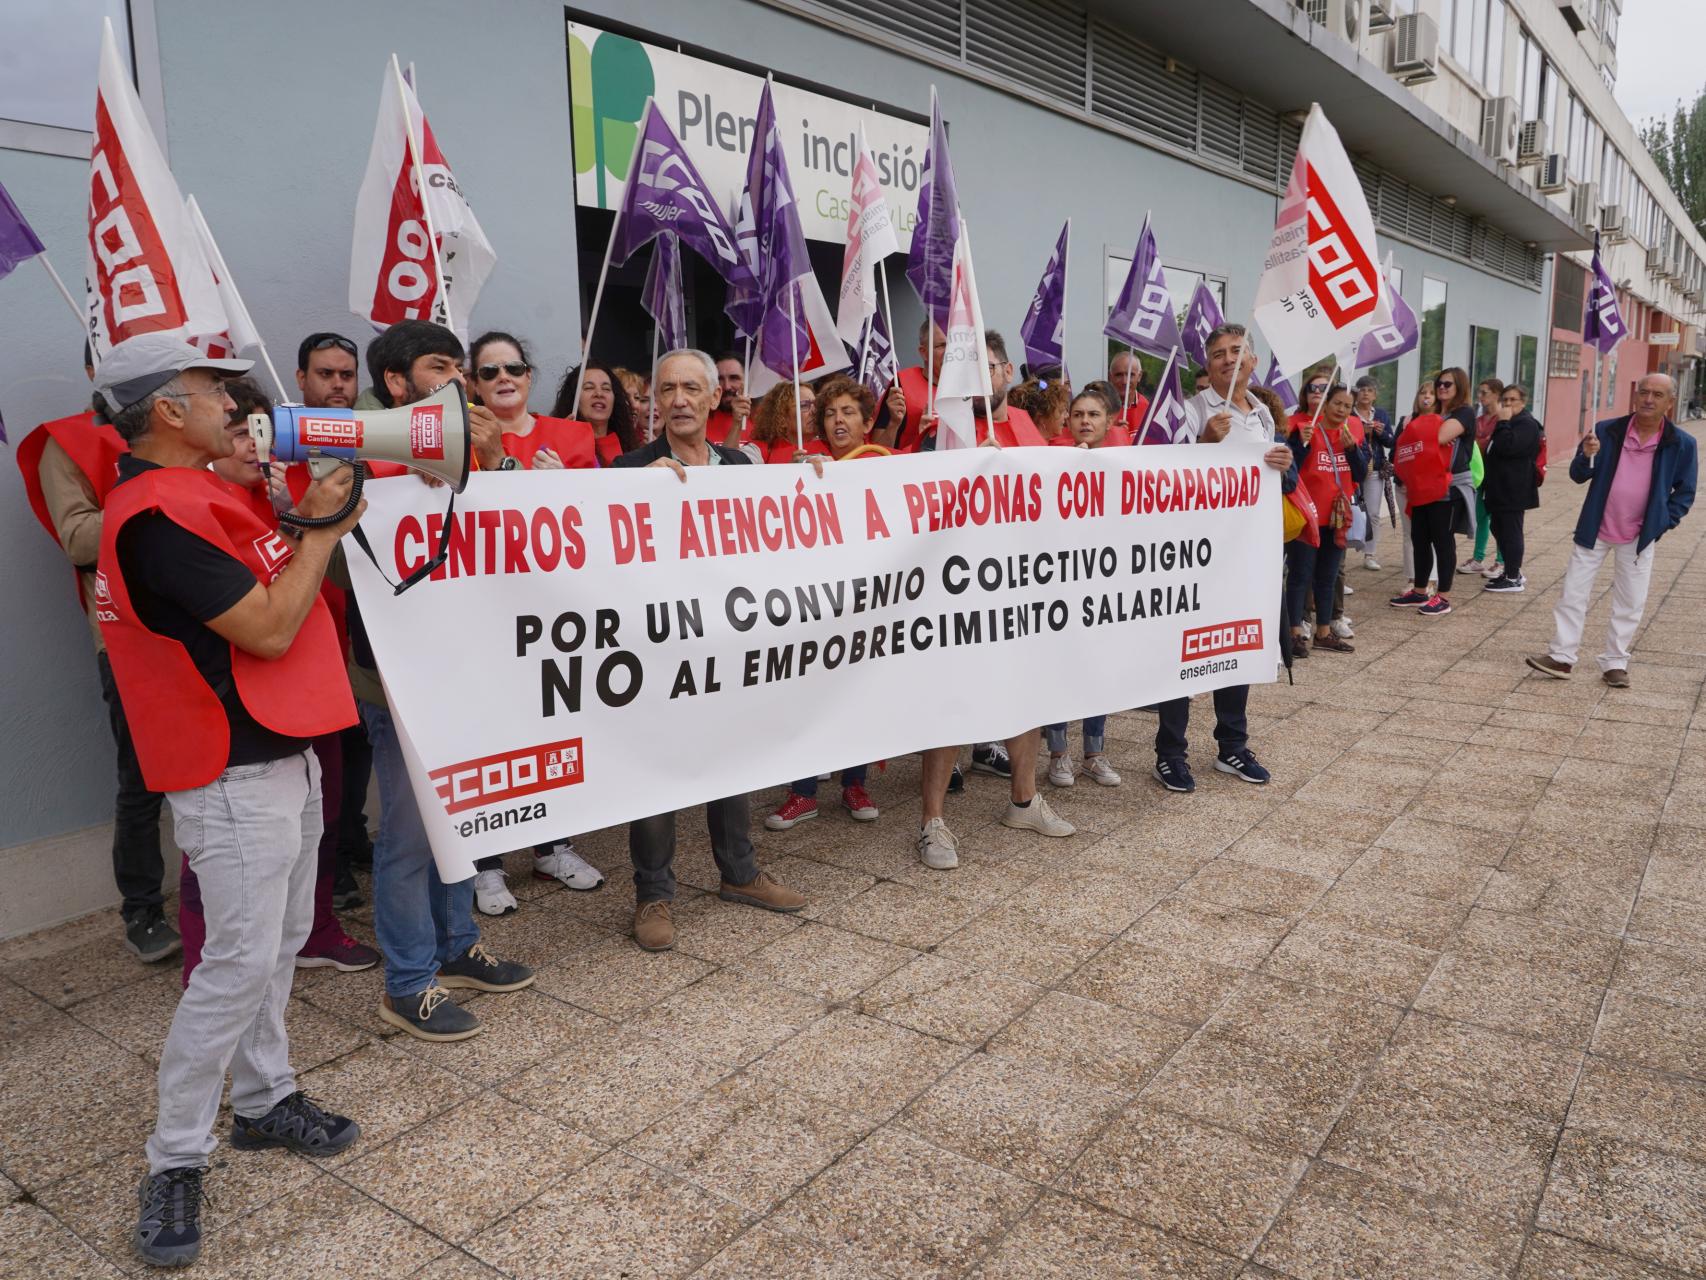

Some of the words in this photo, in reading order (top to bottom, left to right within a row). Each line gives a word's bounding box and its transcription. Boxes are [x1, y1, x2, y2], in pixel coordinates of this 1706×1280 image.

[677, 89, 757, 154] Plen
[637, 138, 738, 265] CCOO
[637, 200, 687, 222] mujer
[307, 435, 333, 443] Castilla
[394, 506, 587, 583] CENTROS
[608, 502, 657, 565] DE
[679, 477, 843, 560] ATENCIÓN
[866, 488, 891, 541] A
[903, 472, 1043, 535] PERSONAS
[1056, 470, 1106, 520] CON
[1120, 465, 1261, 516] DISCAPACIDAD
[516, 608, 621, 657] POR
[646, 598, 704, 644] UN
[724, 566, 925, 632] CONVENIO
[942, 546, 1118, 595] COLECTIVO
[1131, 537, 1213, 575] DIGNO
[541, 650, 643, 718] NO
[669, 656, 721, 700] AL
[742, 599, 1069, 688] EMPOBRECIMIENTO
[1082, 582, 1201, 628] SALARIAL
[1180, 658, 1238, 681] enseñanza
[1185, 626, 1235, 655] CCOO
